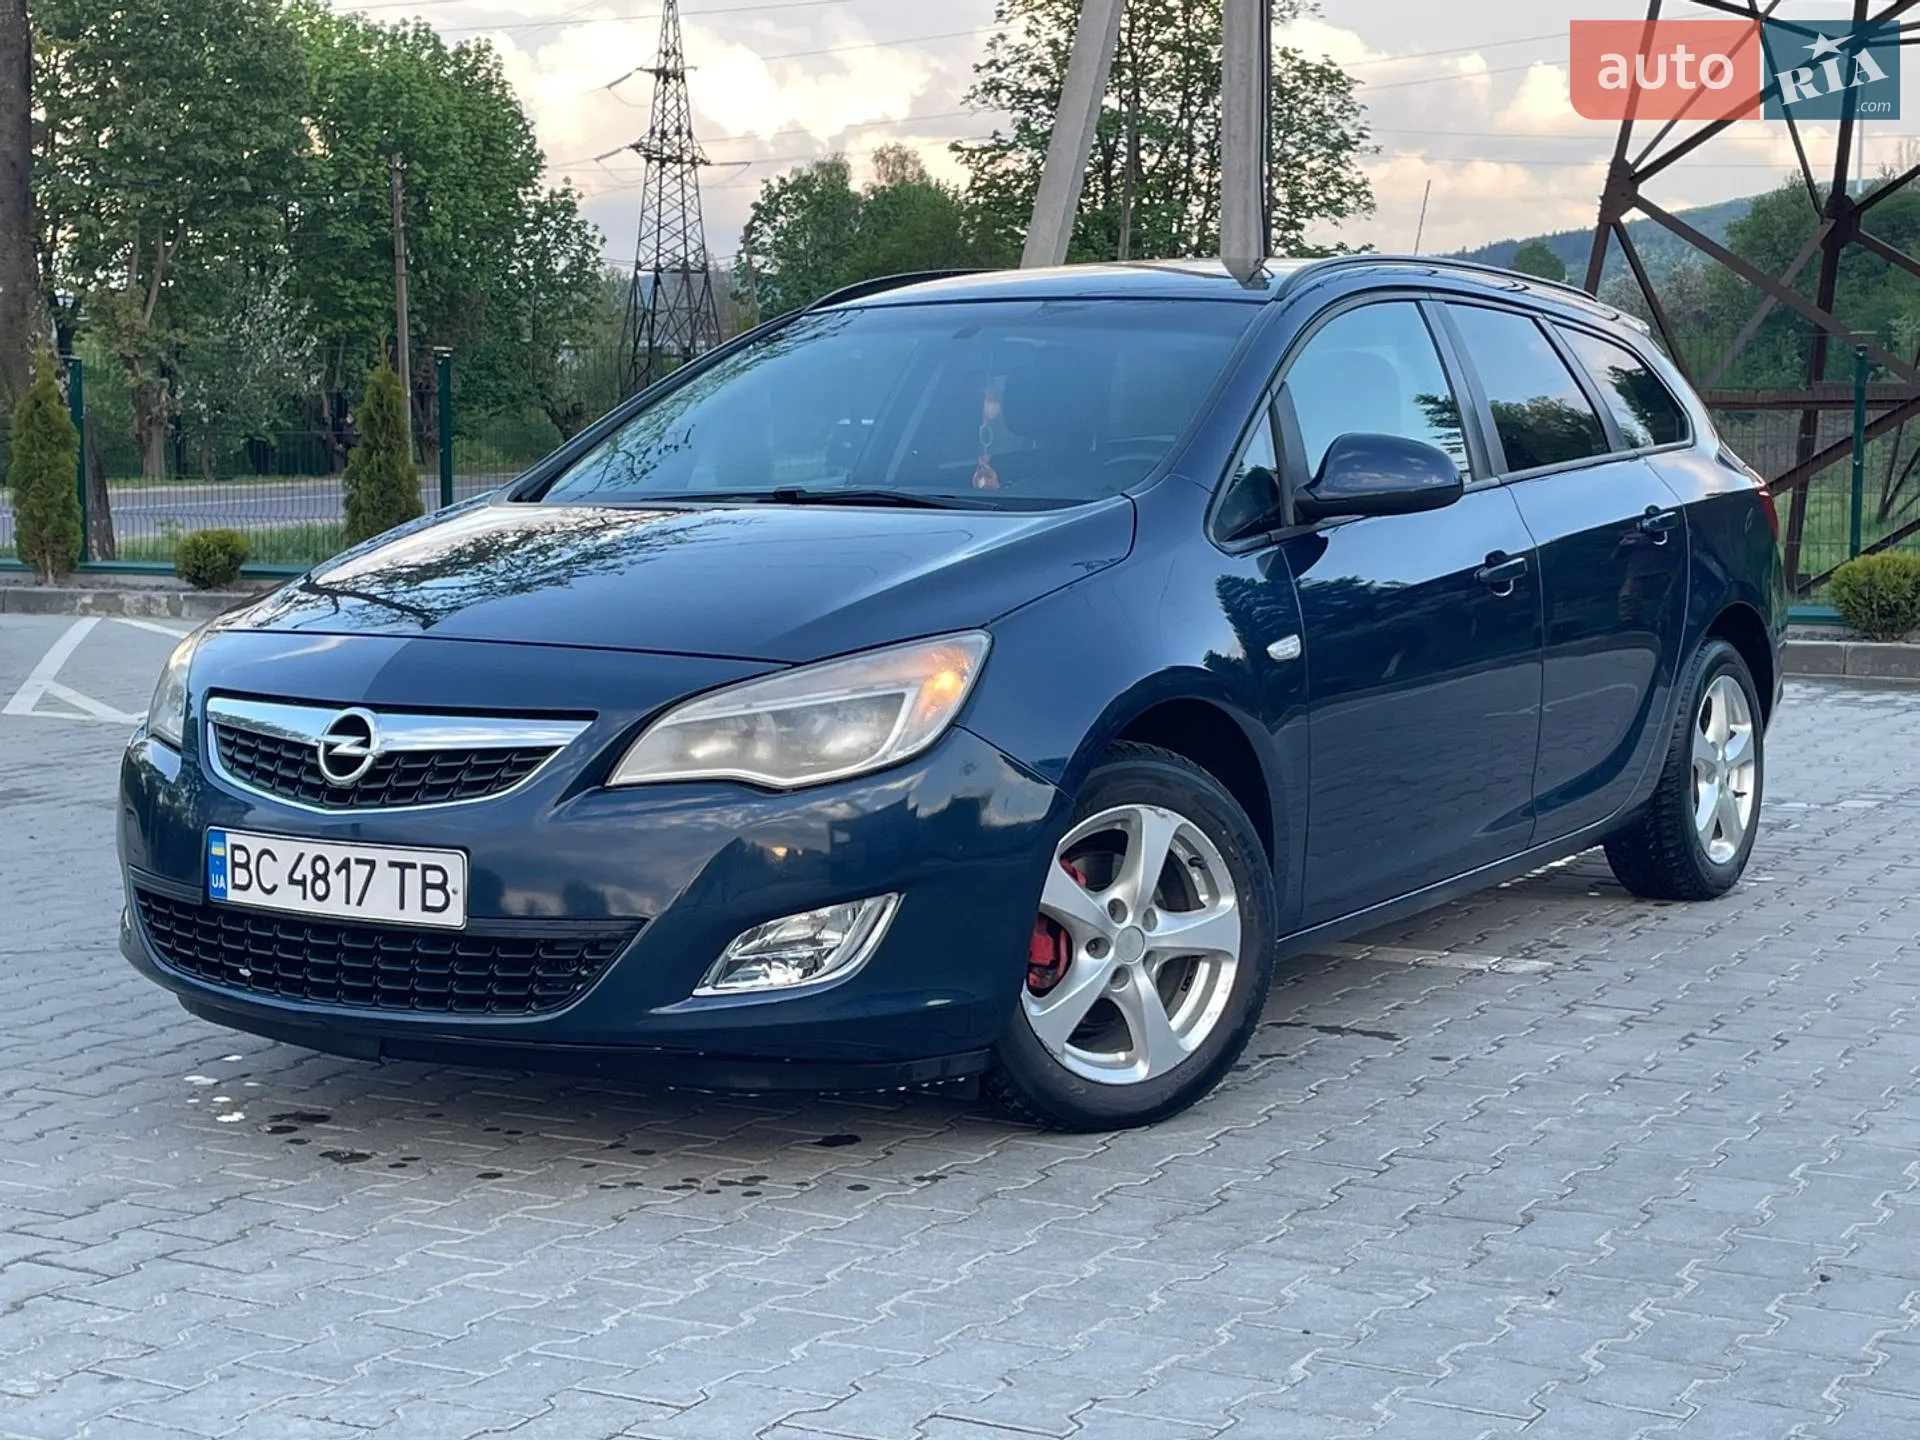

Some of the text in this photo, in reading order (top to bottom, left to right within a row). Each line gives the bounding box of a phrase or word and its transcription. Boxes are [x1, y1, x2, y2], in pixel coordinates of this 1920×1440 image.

[211, 874, 226, 889] UA
[230, 843, 451, 913] BC 4817 TB
